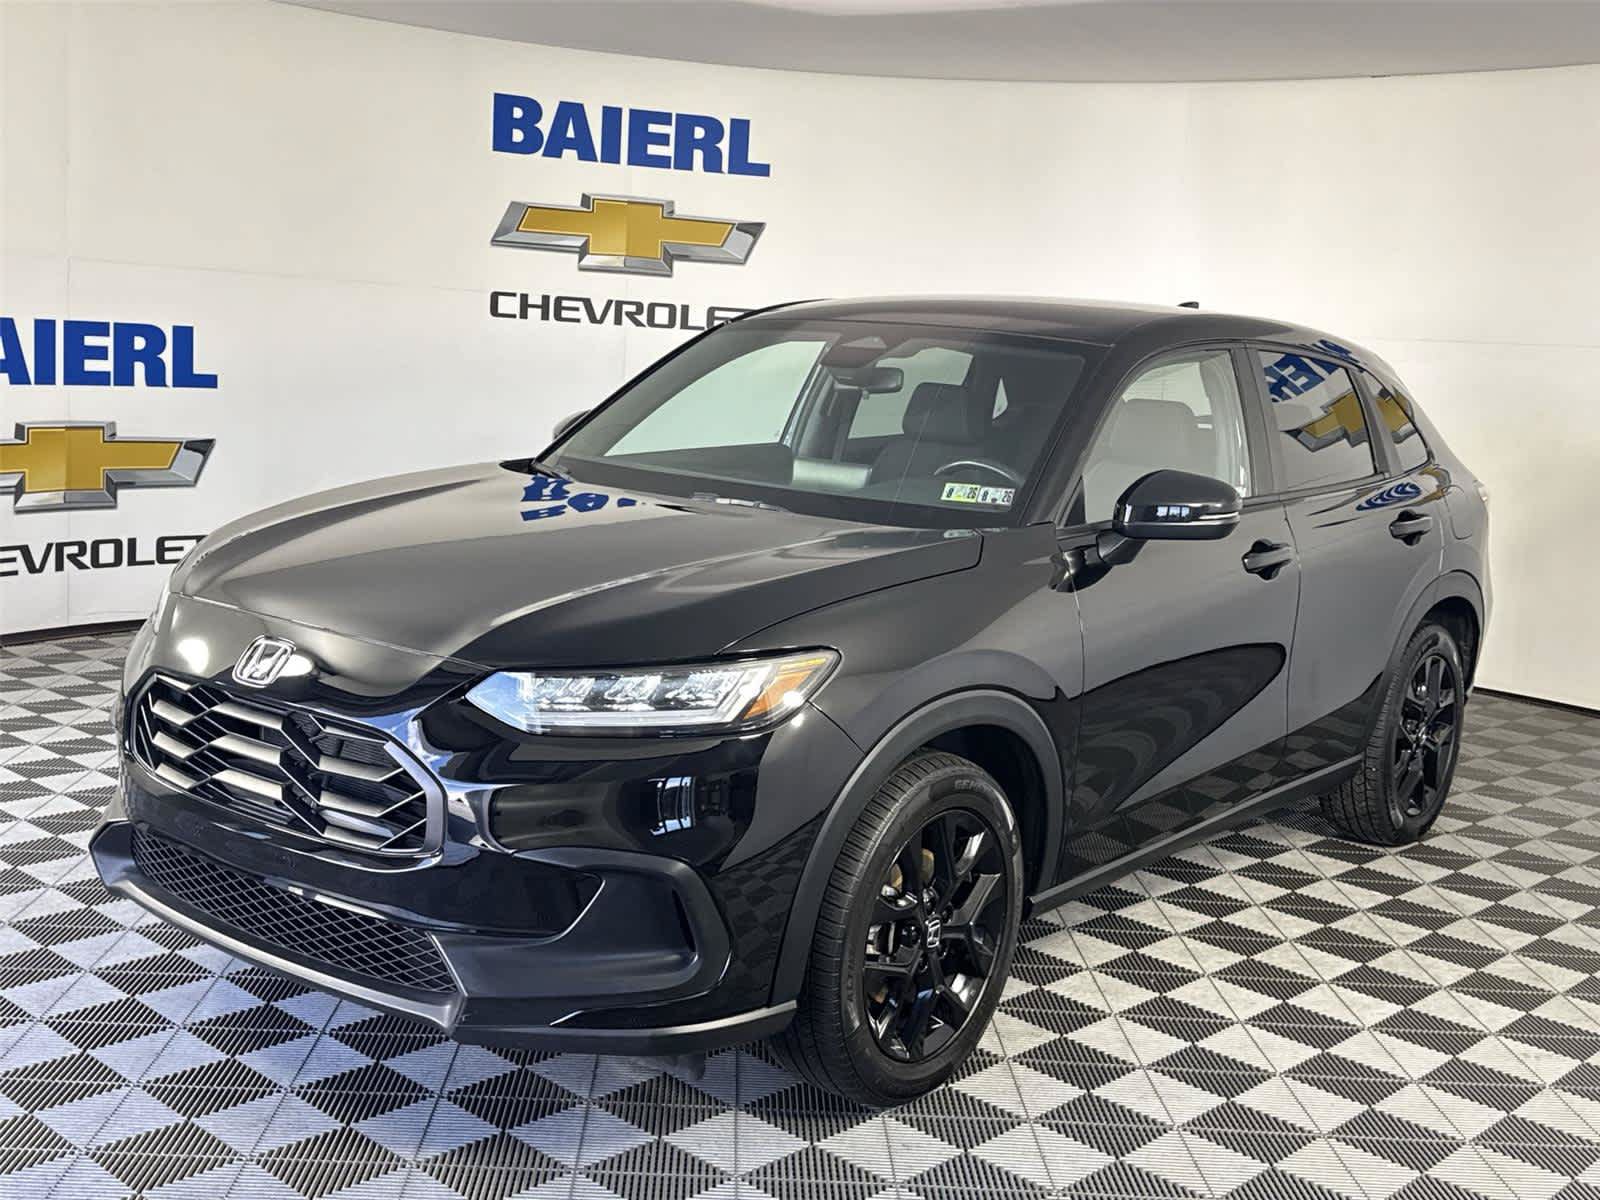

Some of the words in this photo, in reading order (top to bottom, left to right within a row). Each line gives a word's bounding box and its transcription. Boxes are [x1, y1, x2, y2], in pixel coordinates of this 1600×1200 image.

[492, 92, 770, 177] BAIERL
[490, 291, 757, 331] CHEVROLE
[0, 534, 208, 577] EVROLE
